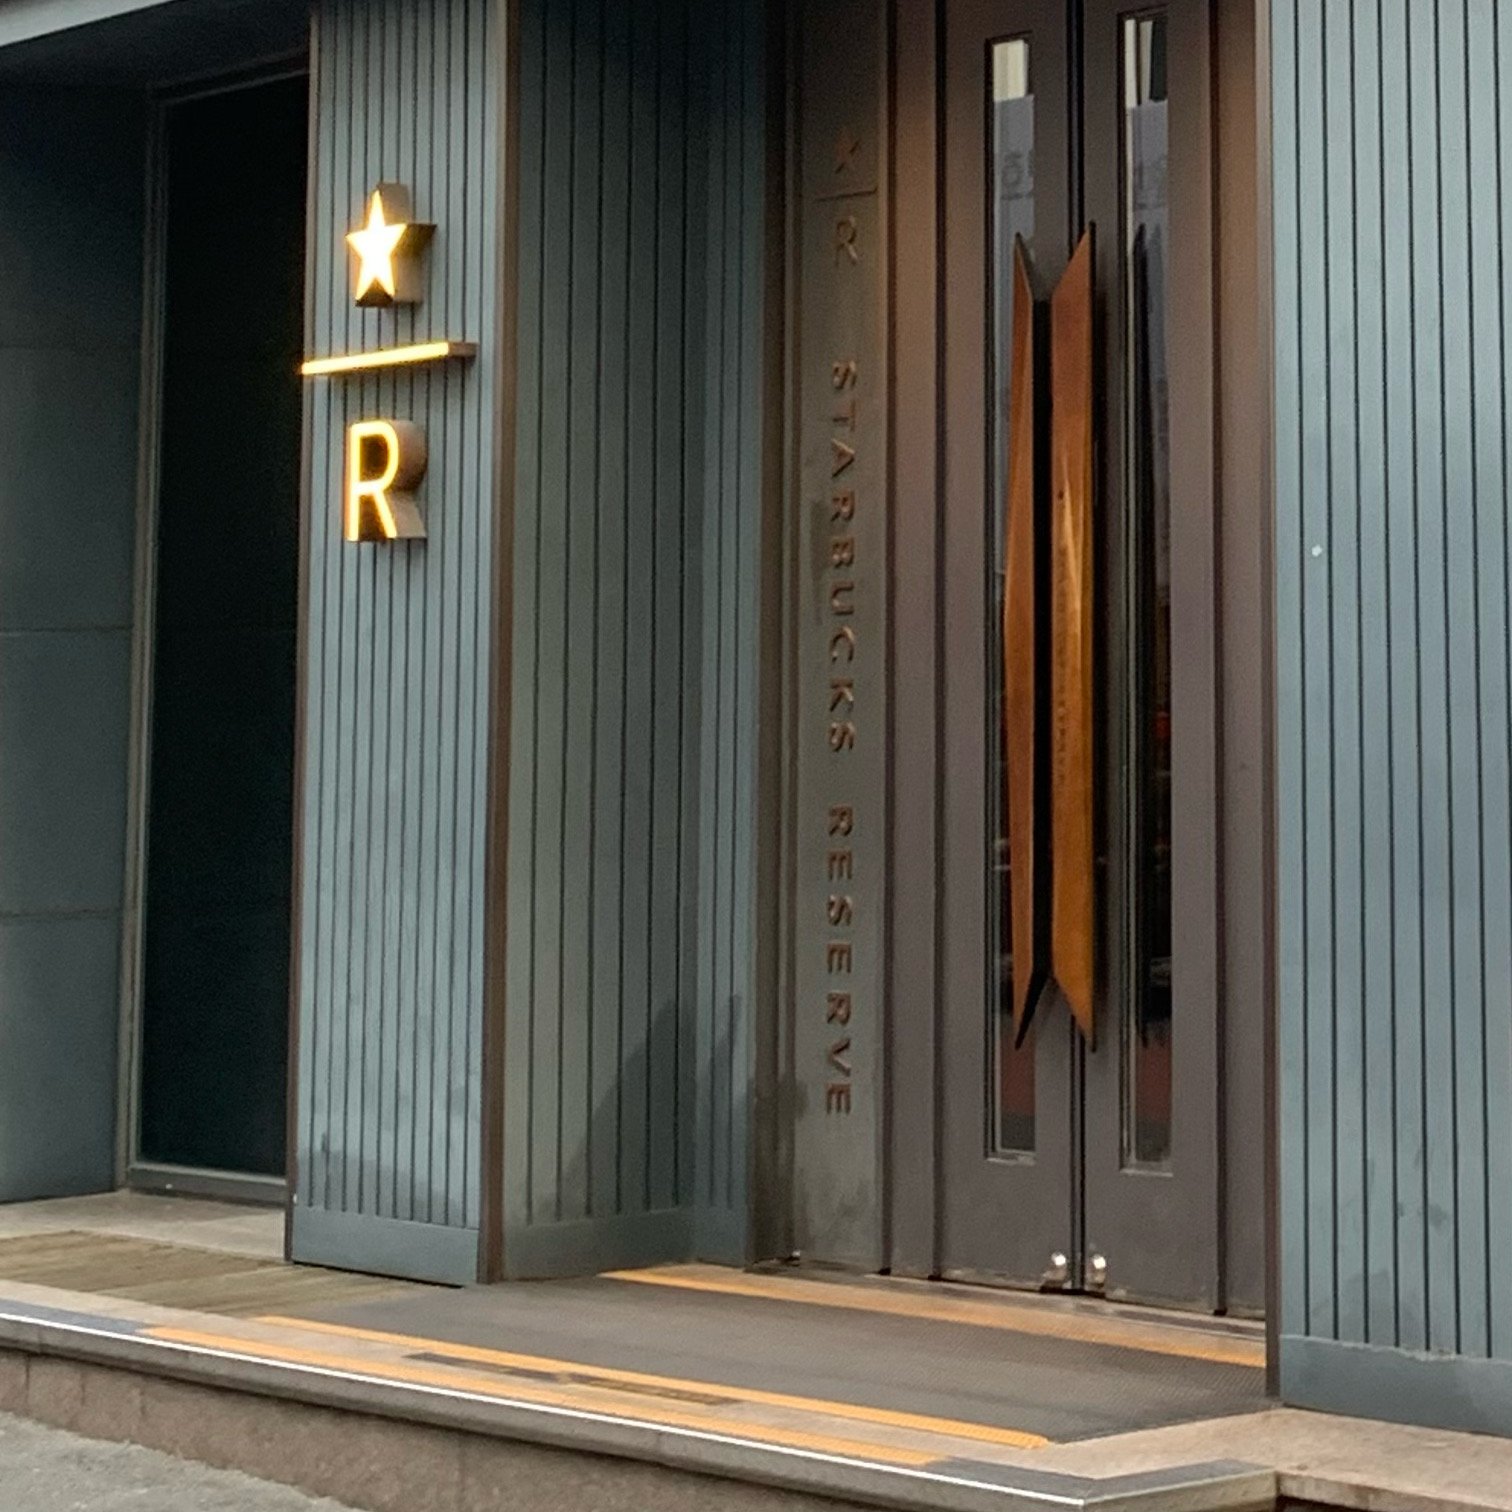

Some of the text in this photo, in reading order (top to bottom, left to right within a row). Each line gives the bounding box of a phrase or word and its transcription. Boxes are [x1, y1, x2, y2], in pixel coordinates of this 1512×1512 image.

[834, 214, 859, 267] R
[346, 420, 399, 542] R
[826, 361, 856, 1115] STARBUCKS RESERVE
